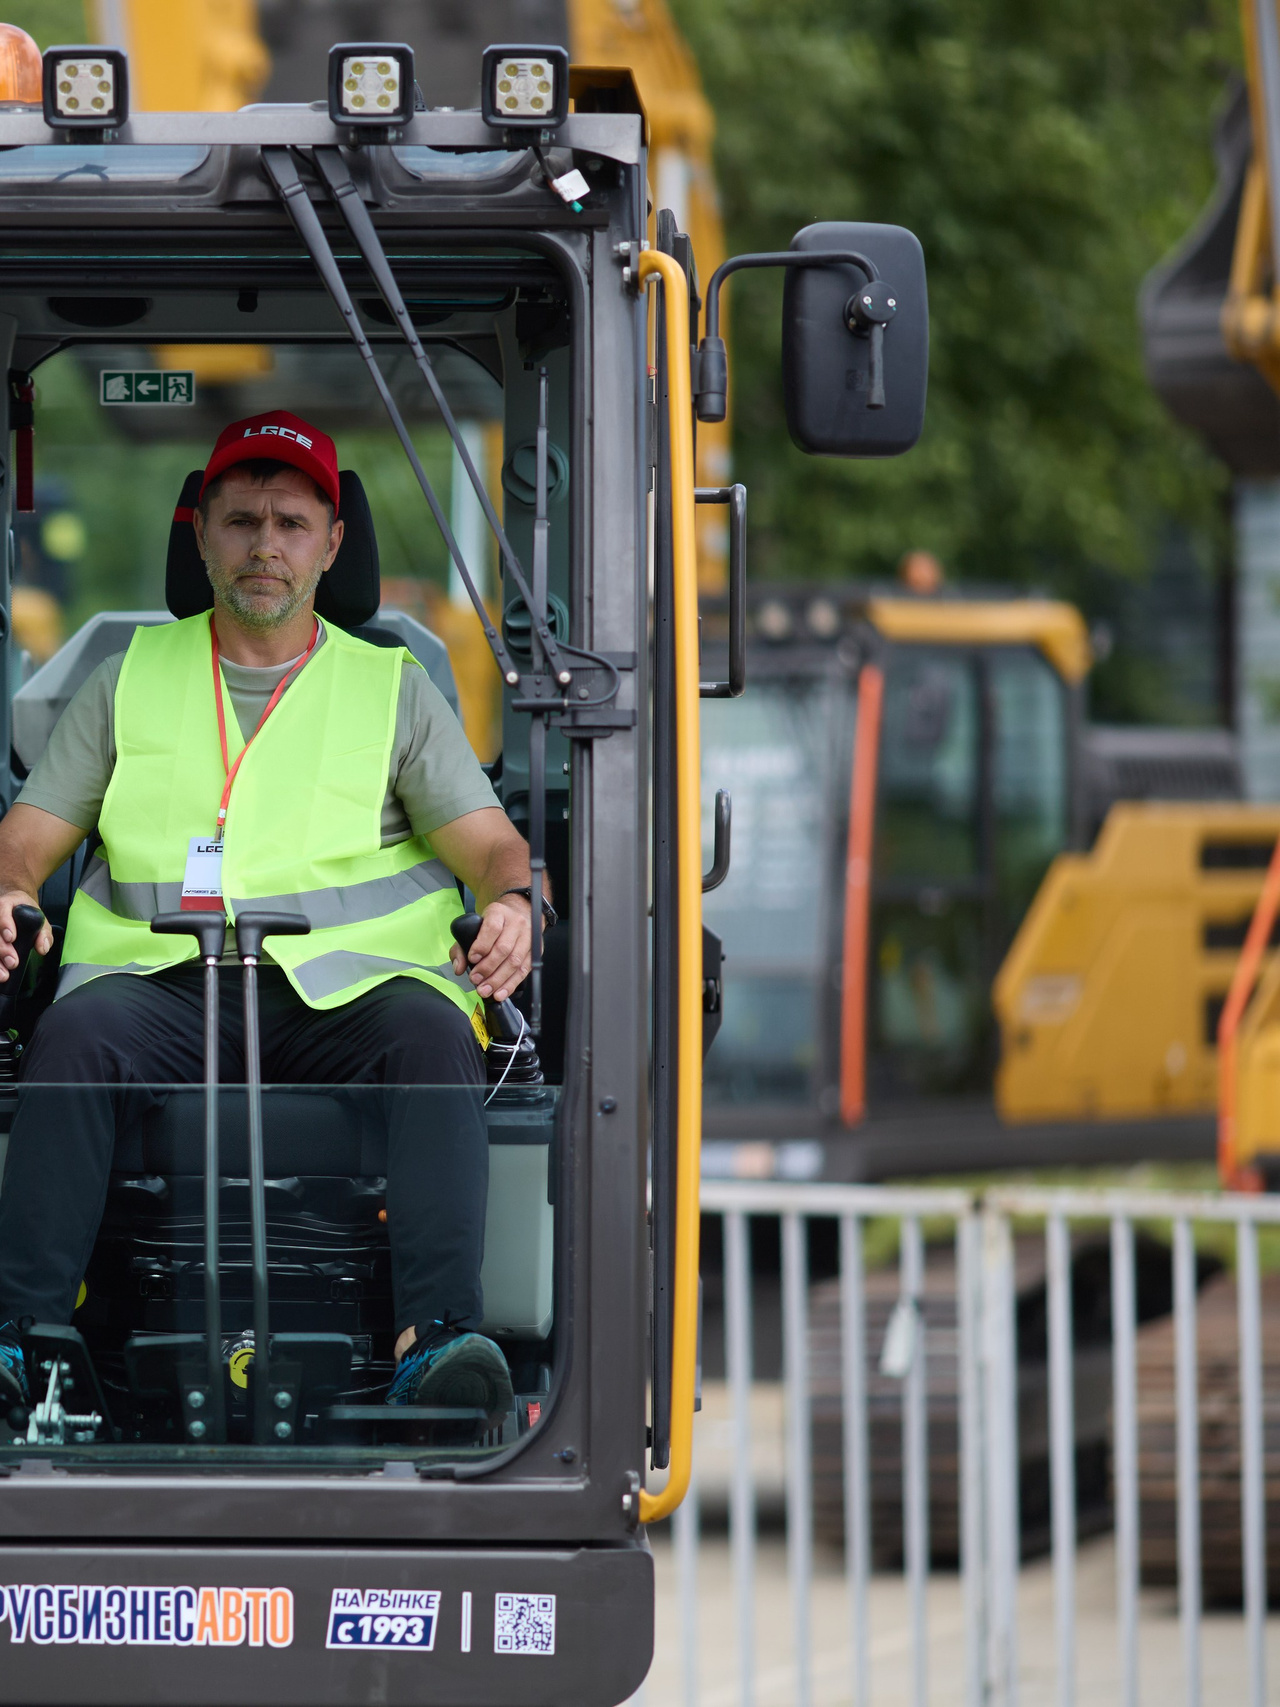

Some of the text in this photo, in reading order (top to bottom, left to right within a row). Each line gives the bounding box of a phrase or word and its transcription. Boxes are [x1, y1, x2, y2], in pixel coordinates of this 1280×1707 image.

[243, 425, 313, 450] LGCE
[197, 845, 224, 853] LGC
[334, 1592, 437, 1609] НА РЫНКЕ
[358, 1615, 425, 1644] 1993
